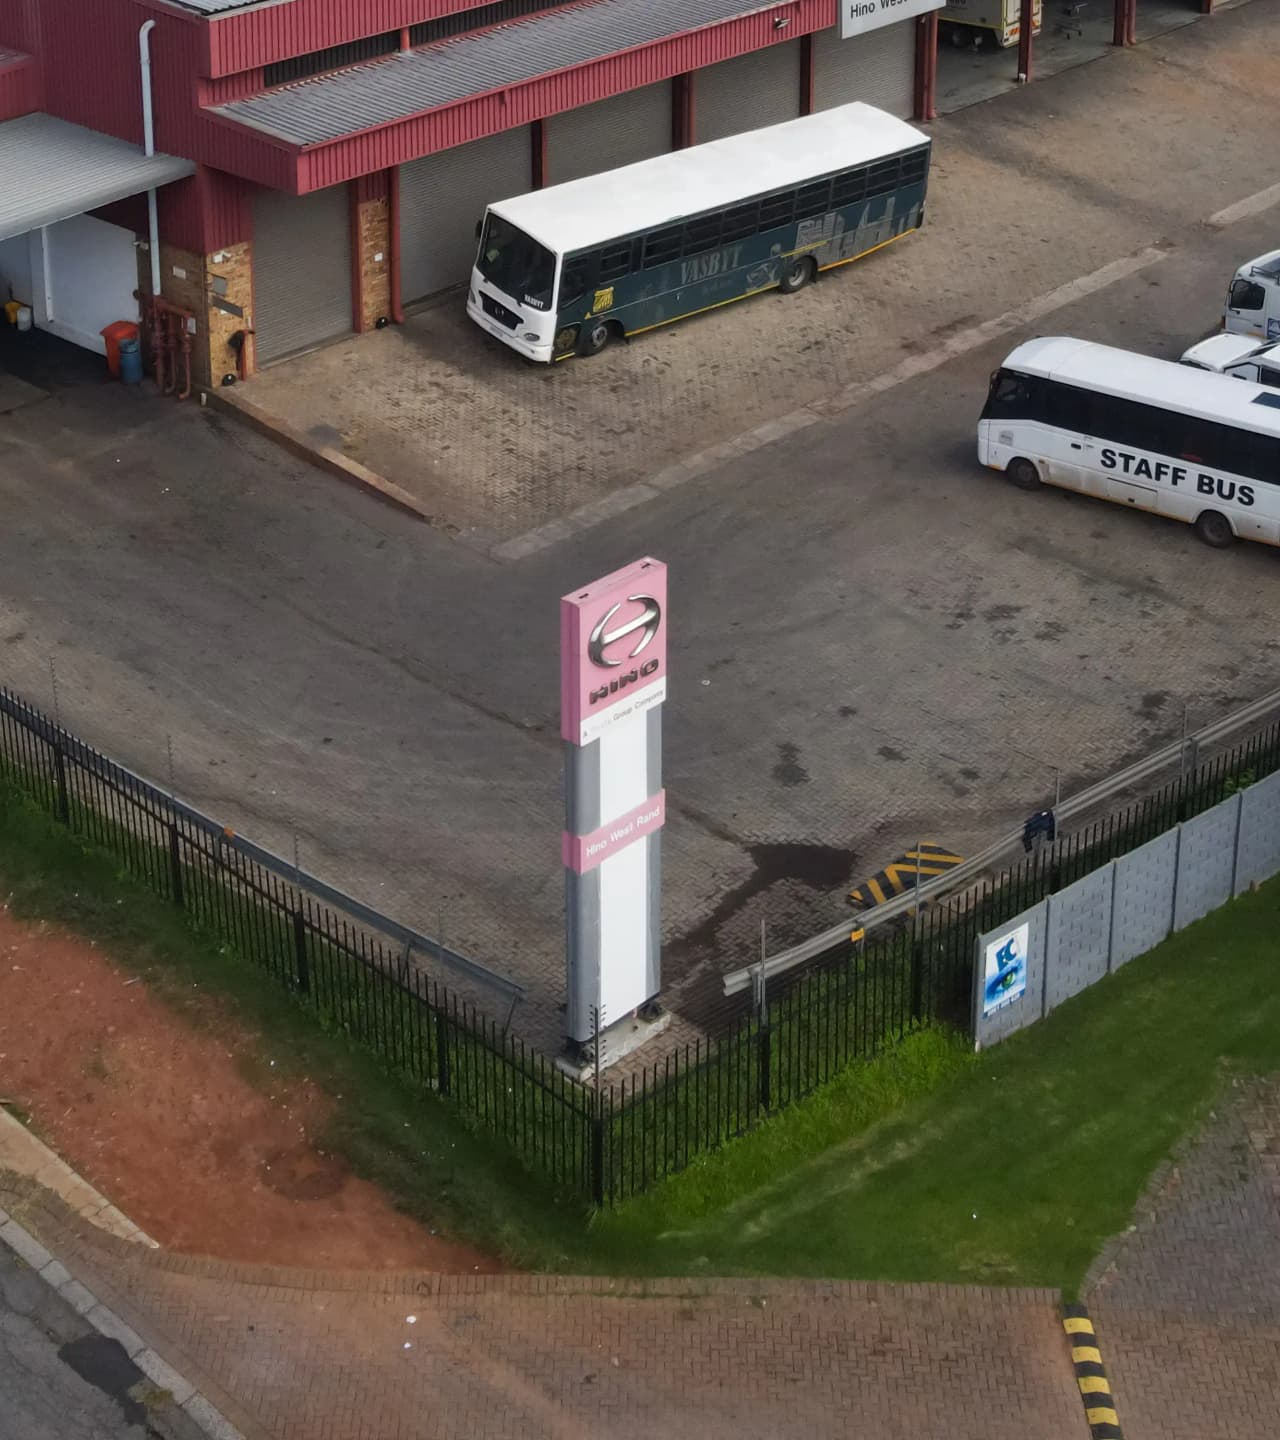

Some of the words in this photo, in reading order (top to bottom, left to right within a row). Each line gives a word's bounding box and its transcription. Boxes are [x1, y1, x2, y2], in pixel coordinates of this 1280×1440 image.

[850, 0, 876, 19] Hino
[1100, 448, 1187, 486] STAFF
[1196, 473, 1255, 506] BUS
[589, 658, 659, 705] HINO
[586, 840, 608, 857] Hino
[610, 821, 634, 842] West
[636, 806, 660, 828] Rand
